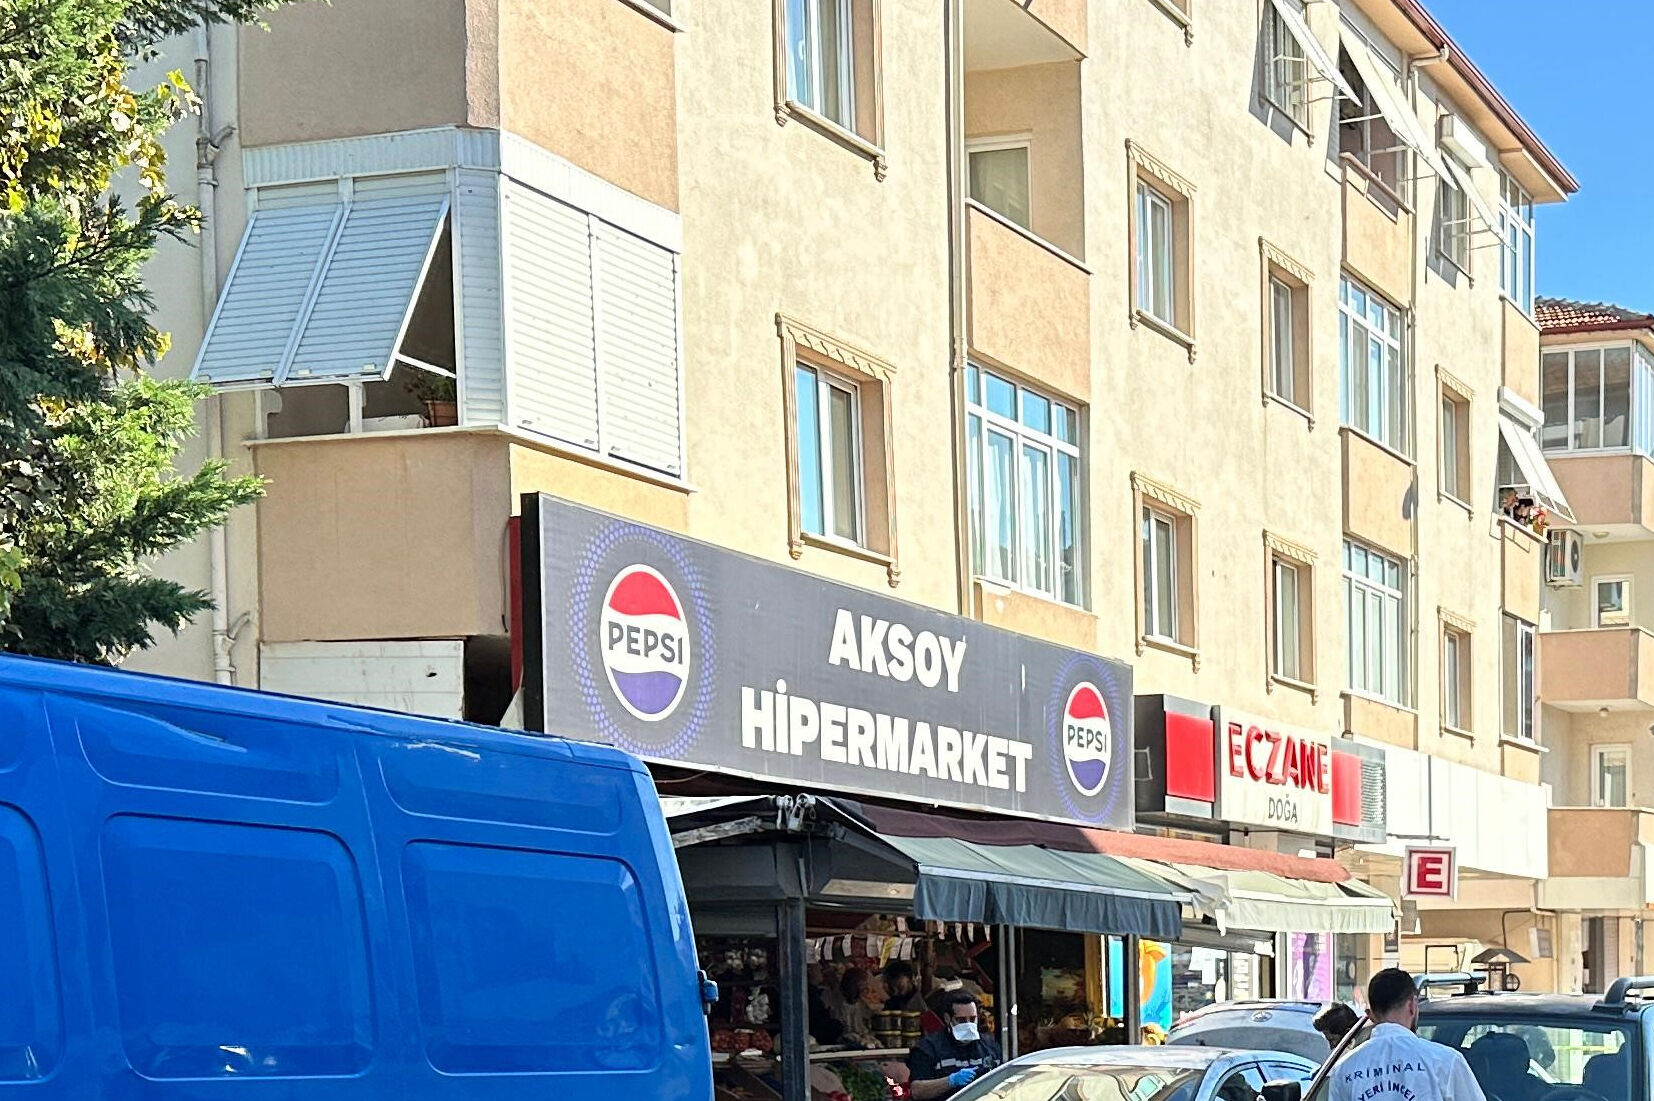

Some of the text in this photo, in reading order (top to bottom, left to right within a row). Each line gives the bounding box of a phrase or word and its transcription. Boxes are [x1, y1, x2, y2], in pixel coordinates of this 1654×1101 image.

[608, 620, 684, 667] PEPSI
[828, 607, 966, 693] AKSOY
[740, 679, 1033, 793] HİPERMARKET
[1067, 724, 1109, 753] PEPSI
[1228, 722, 1330, 795] ECZANE
[1268, 794, 1298, 824] DOĞA
[1416, 856, 1443, 889] E
